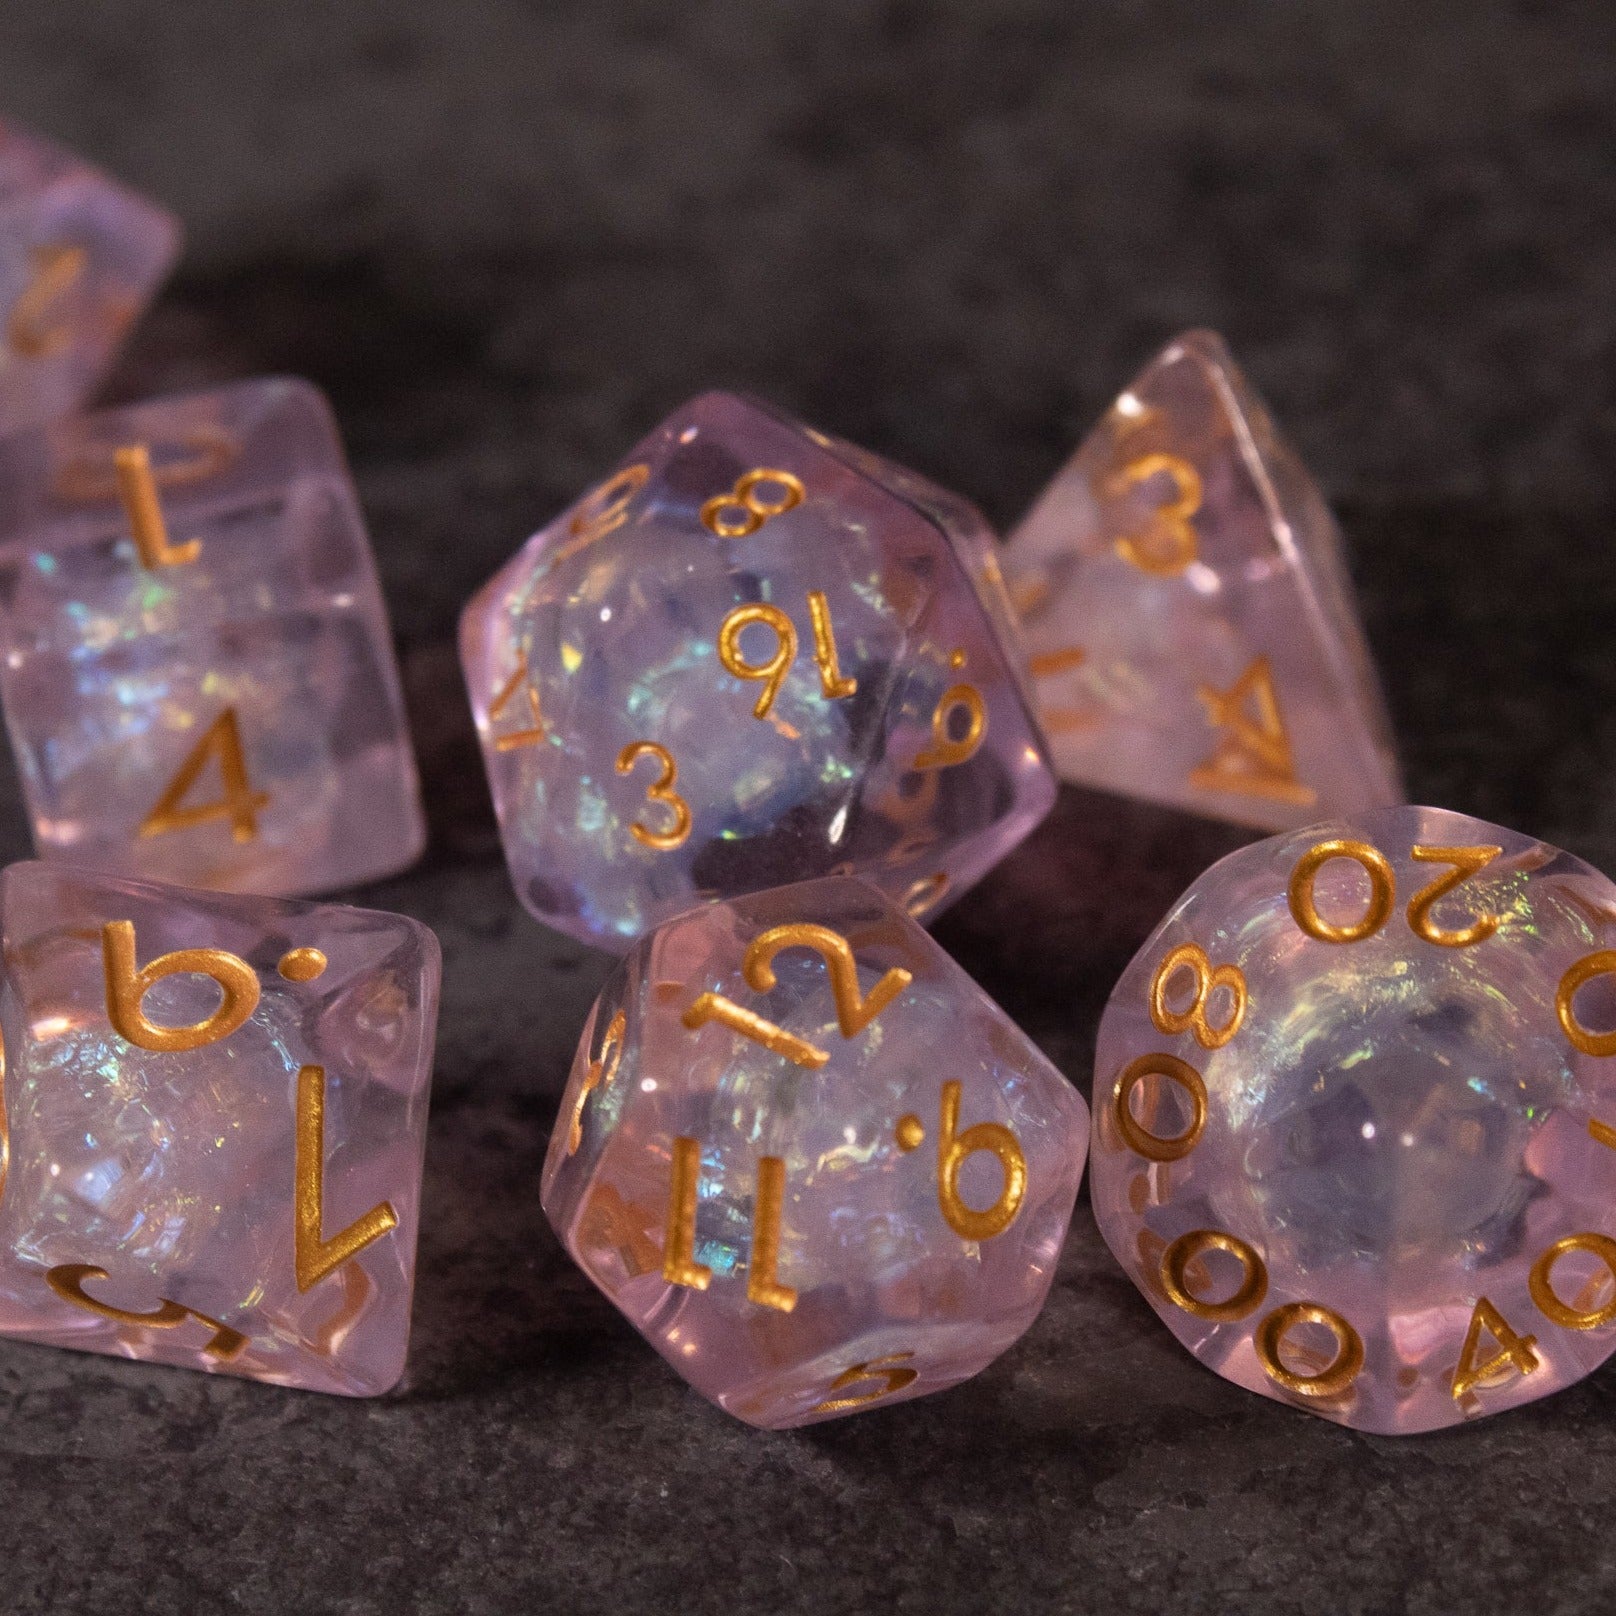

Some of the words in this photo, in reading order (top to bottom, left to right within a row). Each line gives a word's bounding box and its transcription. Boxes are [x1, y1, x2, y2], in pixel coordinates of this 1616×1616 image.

[701, 468, 806, 538] 8
[1104, 452, 1201, 577] 3
[717, 590, 858, 719] 16
[139, 704, 271, 844] 4
[616, 740, 692, 850] 3
[1288, 840, 1502, 948] 20
[682, 923, 913, 1070] 12
[663, 1136, 798, 1314] 11
